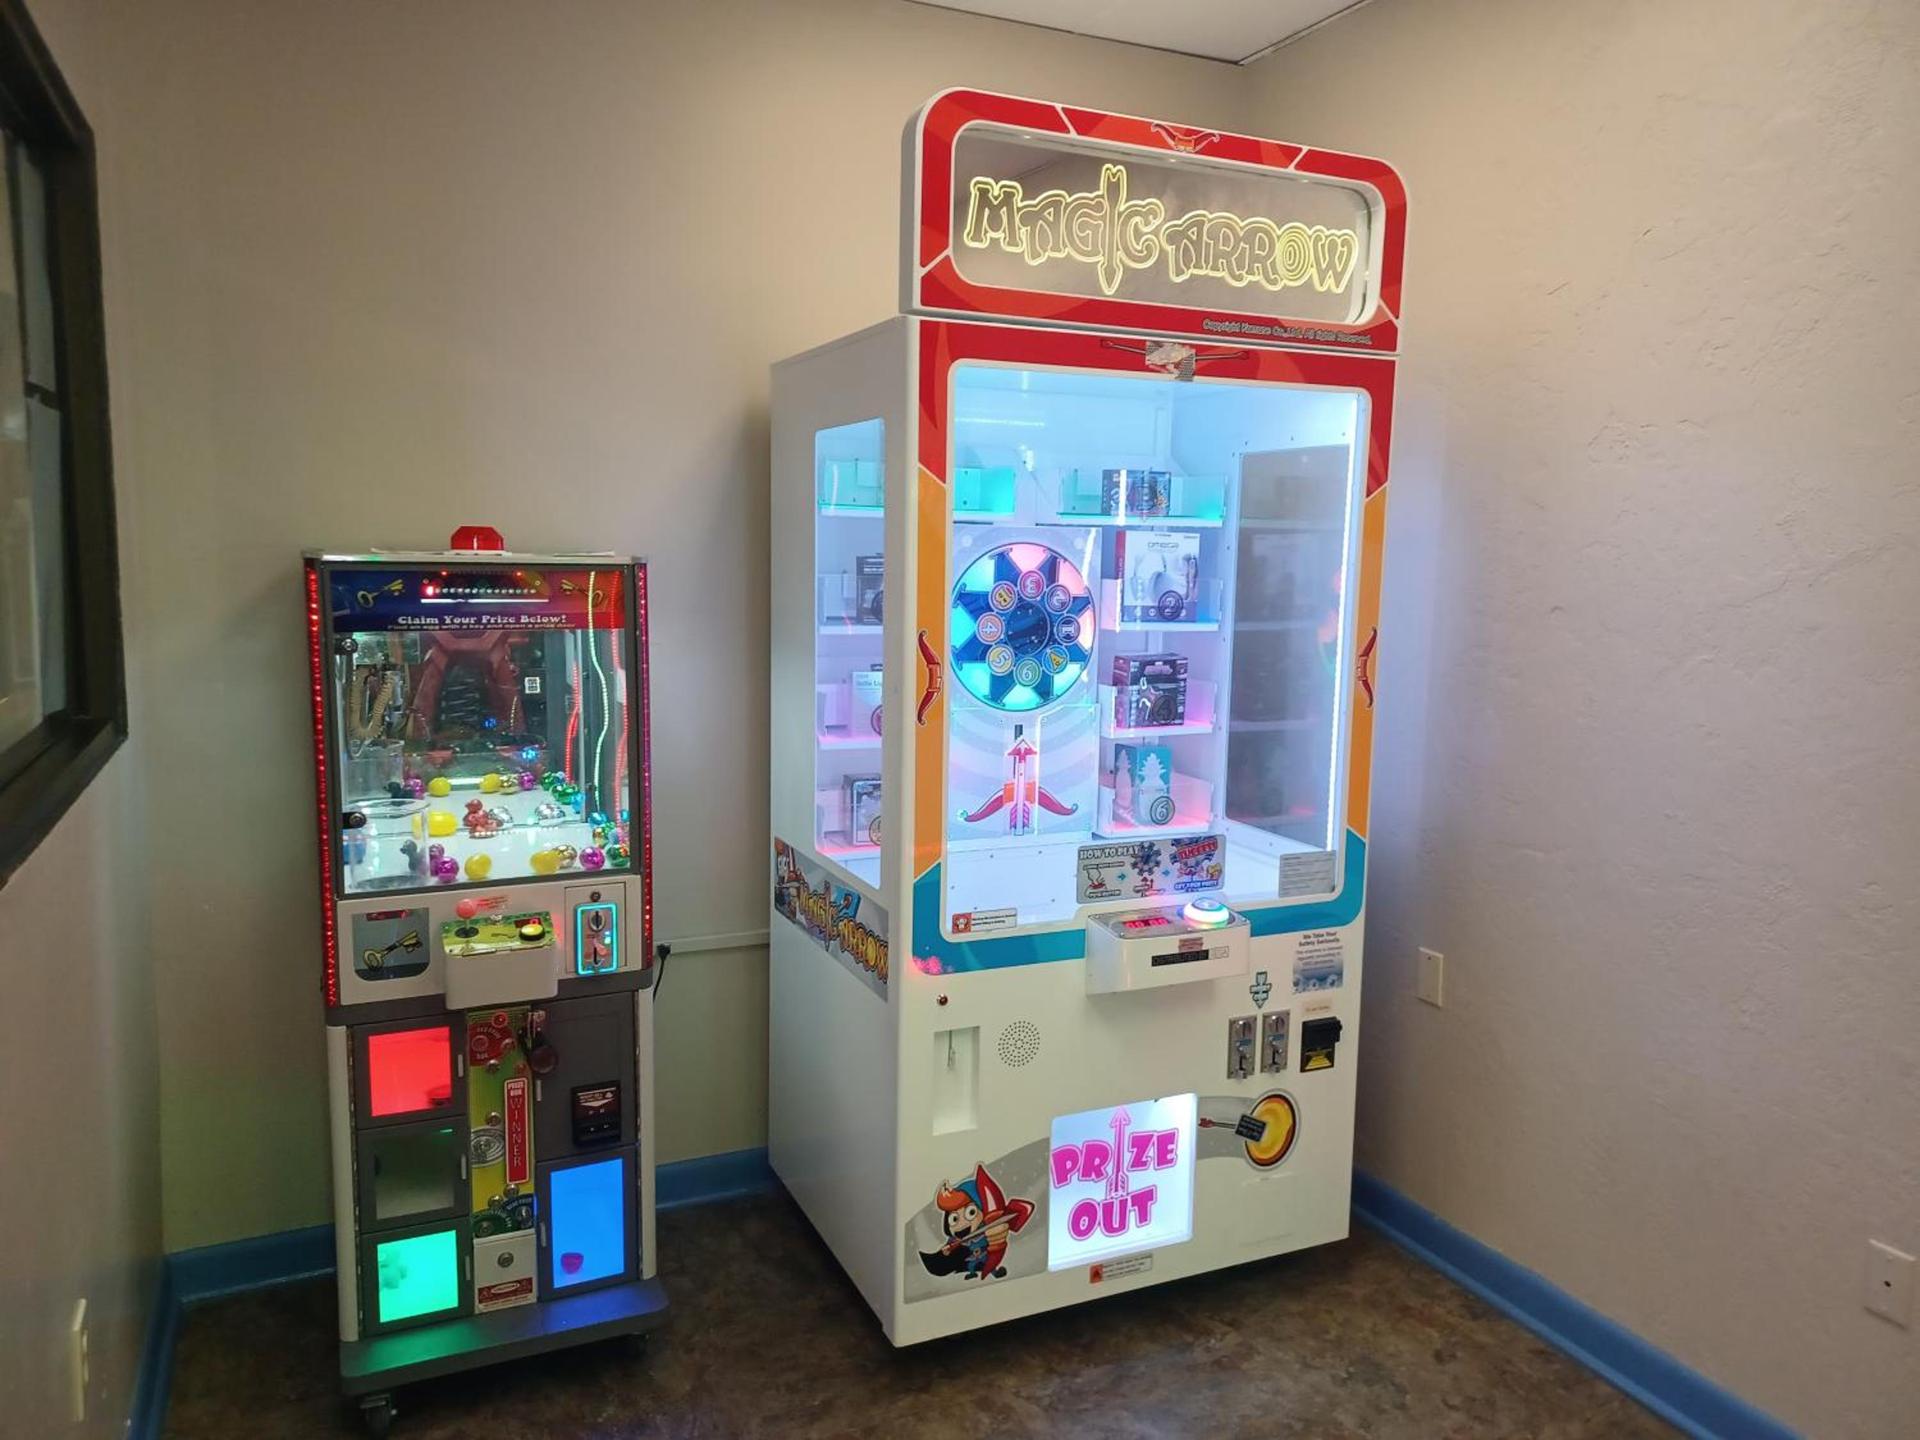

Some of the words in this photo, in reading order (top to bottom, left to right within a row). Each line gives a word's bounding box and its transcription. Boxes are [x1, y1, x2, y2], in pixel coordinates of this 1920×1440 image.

[965, 164, 1164, 295] MAGIC
[1161, 210, 1359, 294] ARROW
[397, 615, 439, 625] Claim
[444, 615, 477, 624] Your
[481, 614, 516, 624] Prize
[520, 614, 568, 624] Below!
[1079, 848, 1103, 860] HOW
[1104, 847, 1117, 858] TO
[1117, 845, 1140, 857] PLAY
[510, 1098, 523, 1168] WINNER
[1051, 1106, 1179, 1198] PRIZE
[1068, 1185, 1157, 1241] OUT
